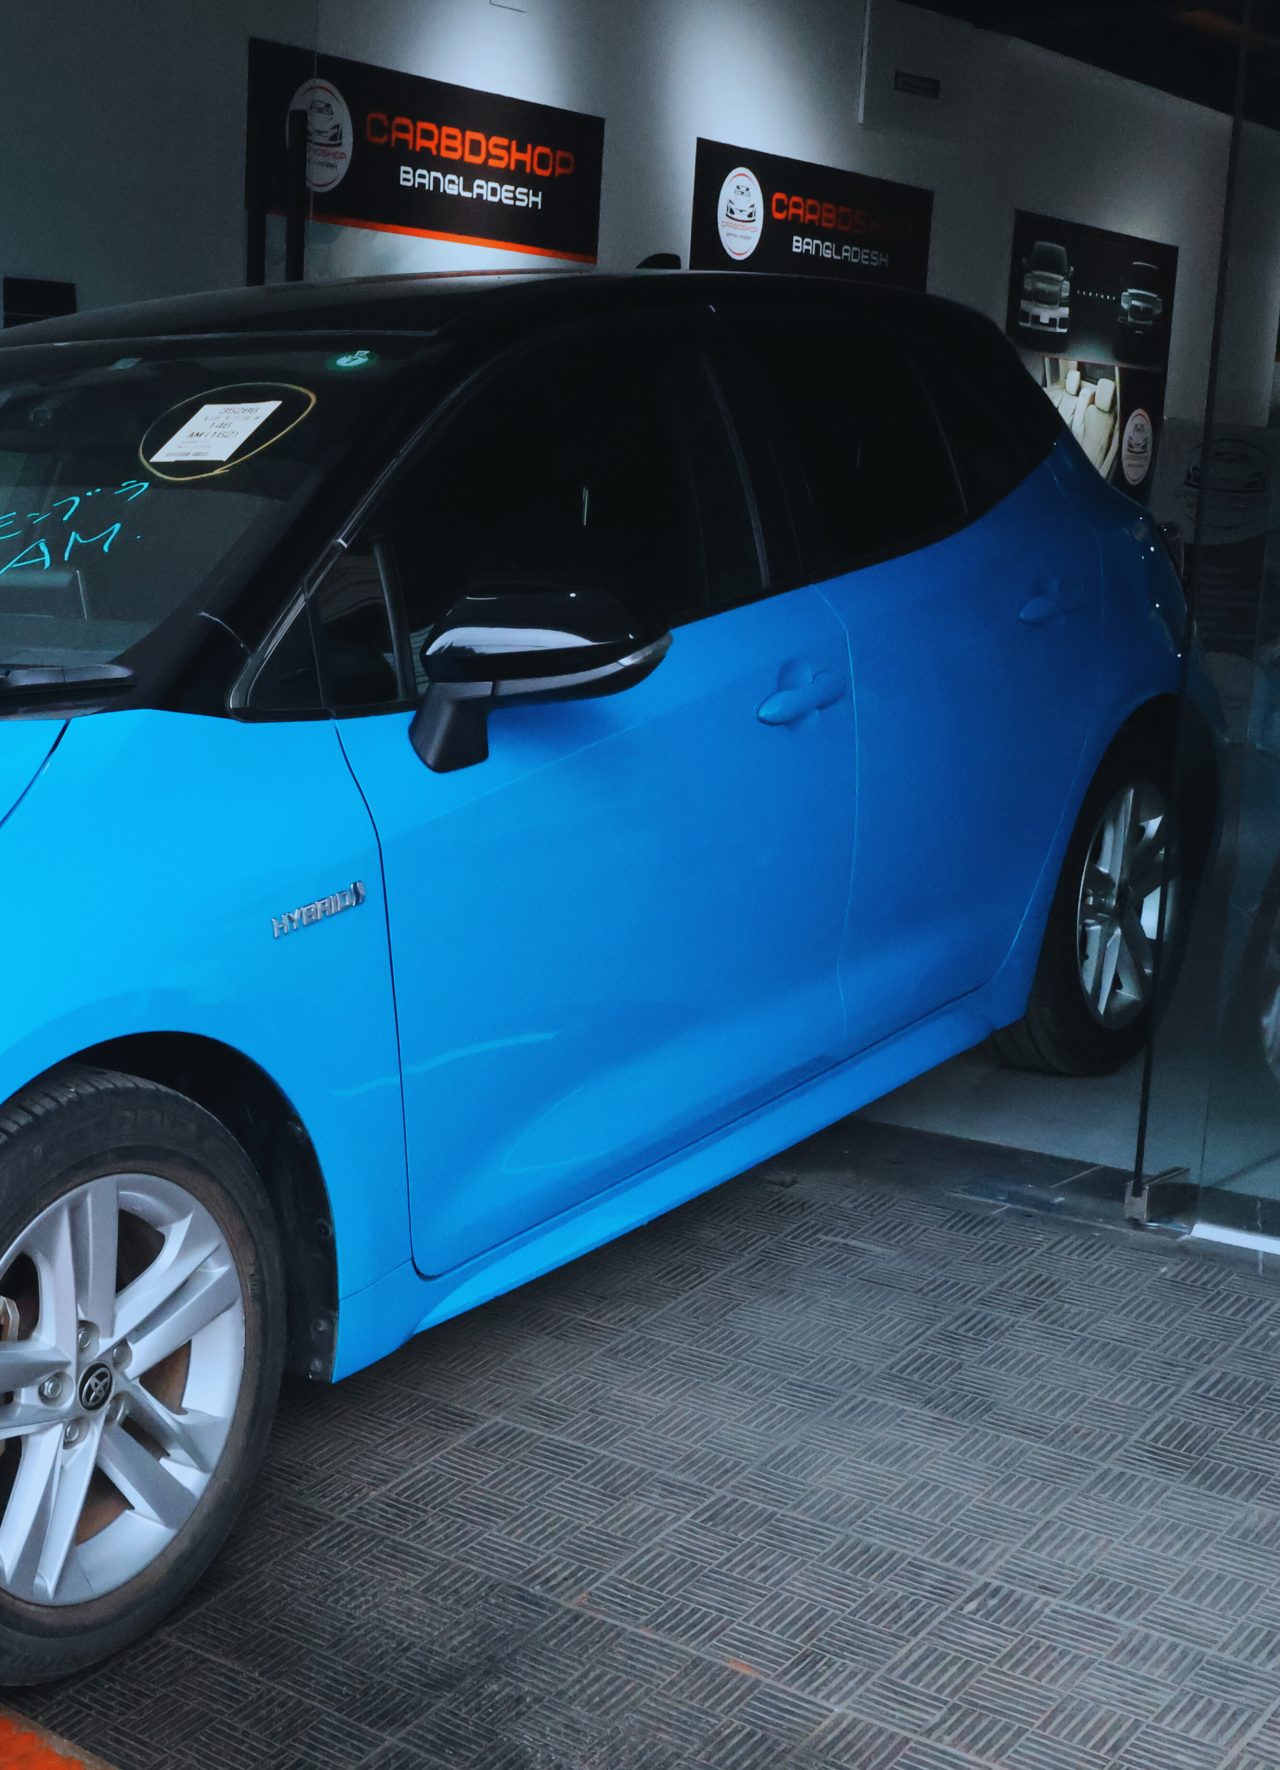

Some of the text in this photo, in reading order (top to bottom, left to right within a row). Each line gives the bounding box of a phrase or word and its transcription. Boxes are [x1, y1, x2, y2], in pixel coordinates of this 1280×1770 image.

[366, 112, 576, 178] CARBDSHOP
[399, 165, 542, 210] BANGLADESH
[792, 235, 889, 268] BANGLADESH
[271, 880, 365, 938] HYBRID
